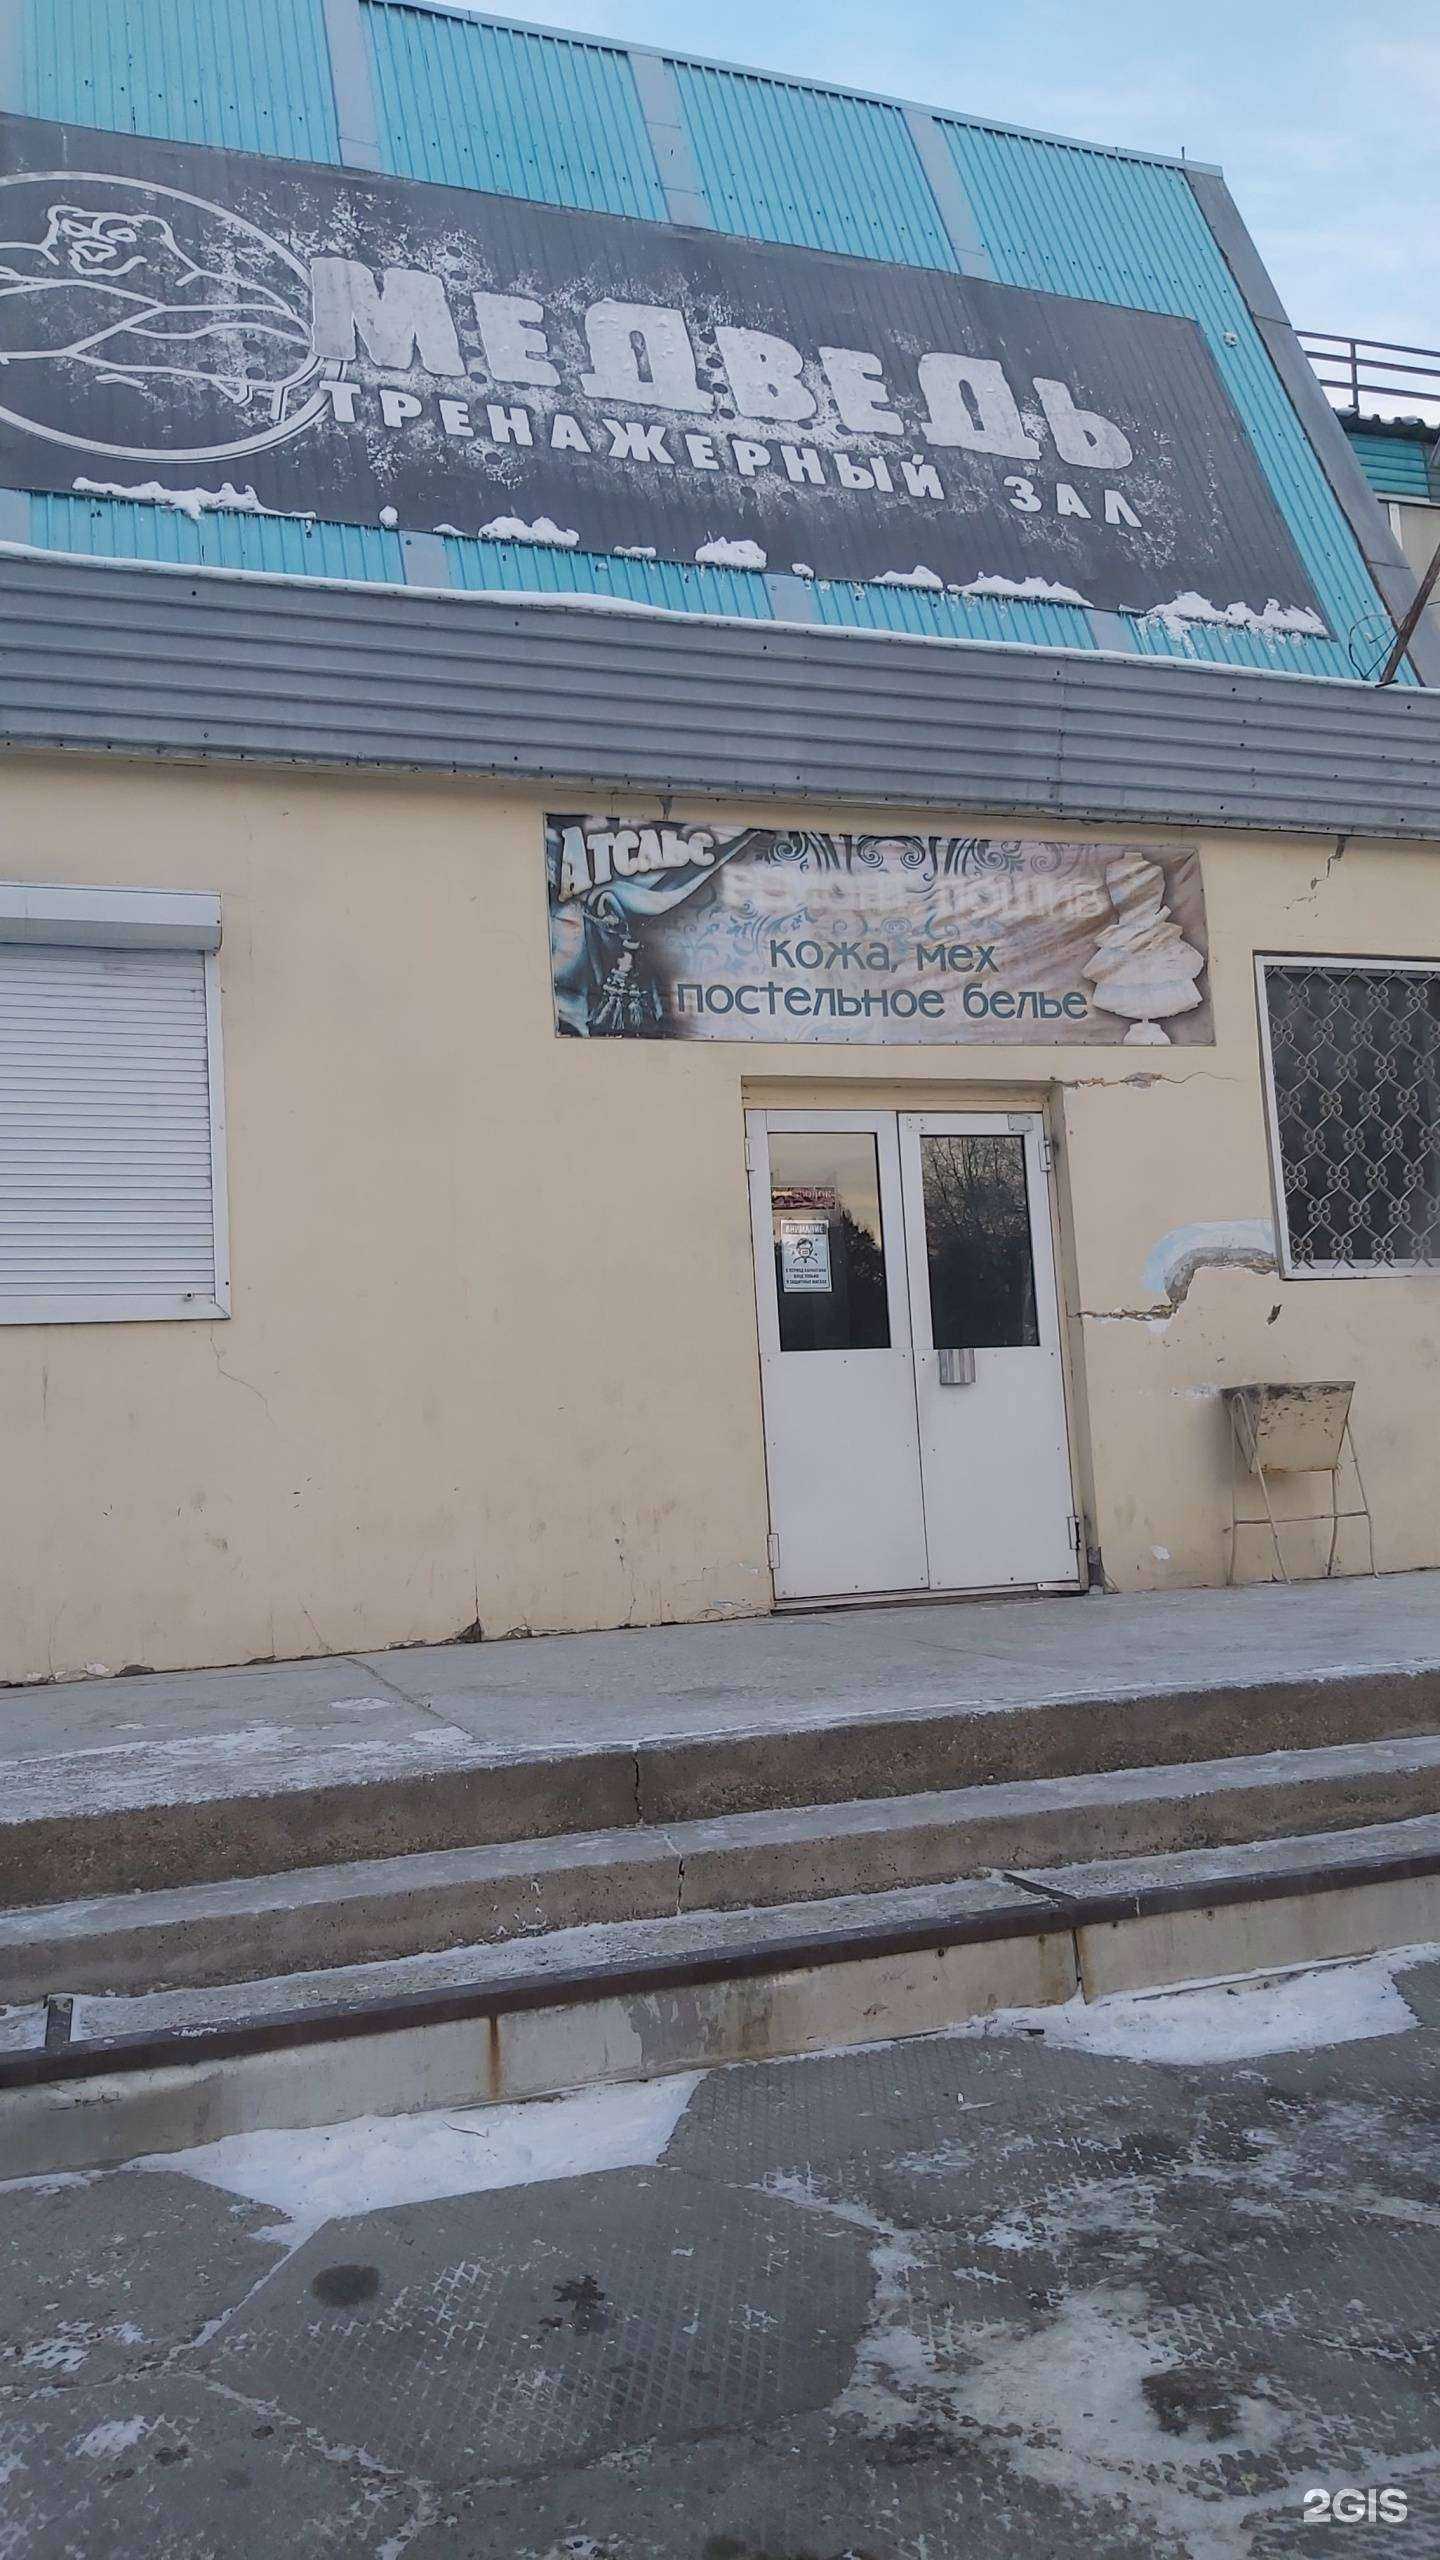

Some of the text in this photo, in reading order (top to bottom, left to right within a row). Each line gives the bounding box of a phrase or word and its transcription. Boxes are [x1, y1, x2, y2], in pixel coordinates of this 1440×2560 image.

[310, 257, 1133, 470] МЕДВЕДЬ
[319, 380, 1142, 528] ТРЕНАЖЕРНЫЙ ЗАЛ
[677, 981, 1087, 1019] постельное белье
[770, 938, 1000, 973] кожа, мех
